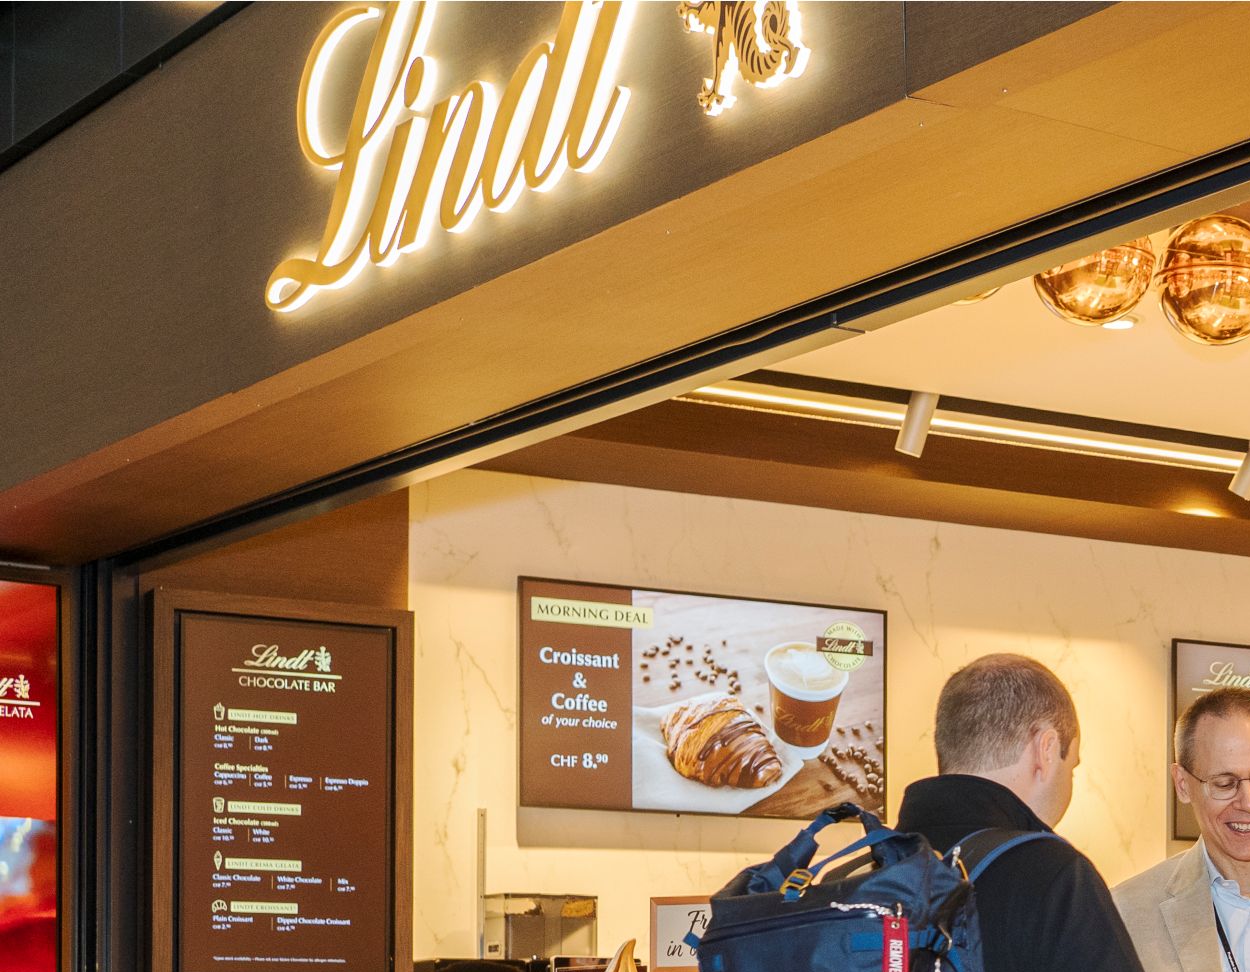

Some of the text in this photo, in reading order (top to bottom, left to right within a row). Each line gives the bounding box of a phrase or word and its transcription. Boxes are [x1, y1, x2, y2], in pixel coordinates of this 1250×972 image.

[537, 603, 649, 624] MORNING DEAL
[822, 638, 856, 652] Lindt
[244, 644, 316, 671] Lindt
[539, 647, 620, 669] Croissant
[238, 676, 336, 693] CHOCOLATE BAR
[572, 672, 587, 689] &
[551, 693, 608, 712] Coffee
[0, 706, 34, 719] ELATA
[228, 725, 260, 735] Chocolate
[541, 714, 617, 730] of your choice
[214, 763, 269, 773] Coffee Specialties
[550, 752, 609, 770] CHF 8.90
[213, 817, 228, 825] Iced
[228, 818, 261, 827] Chocolate
[667, 940, 682, 957] in
